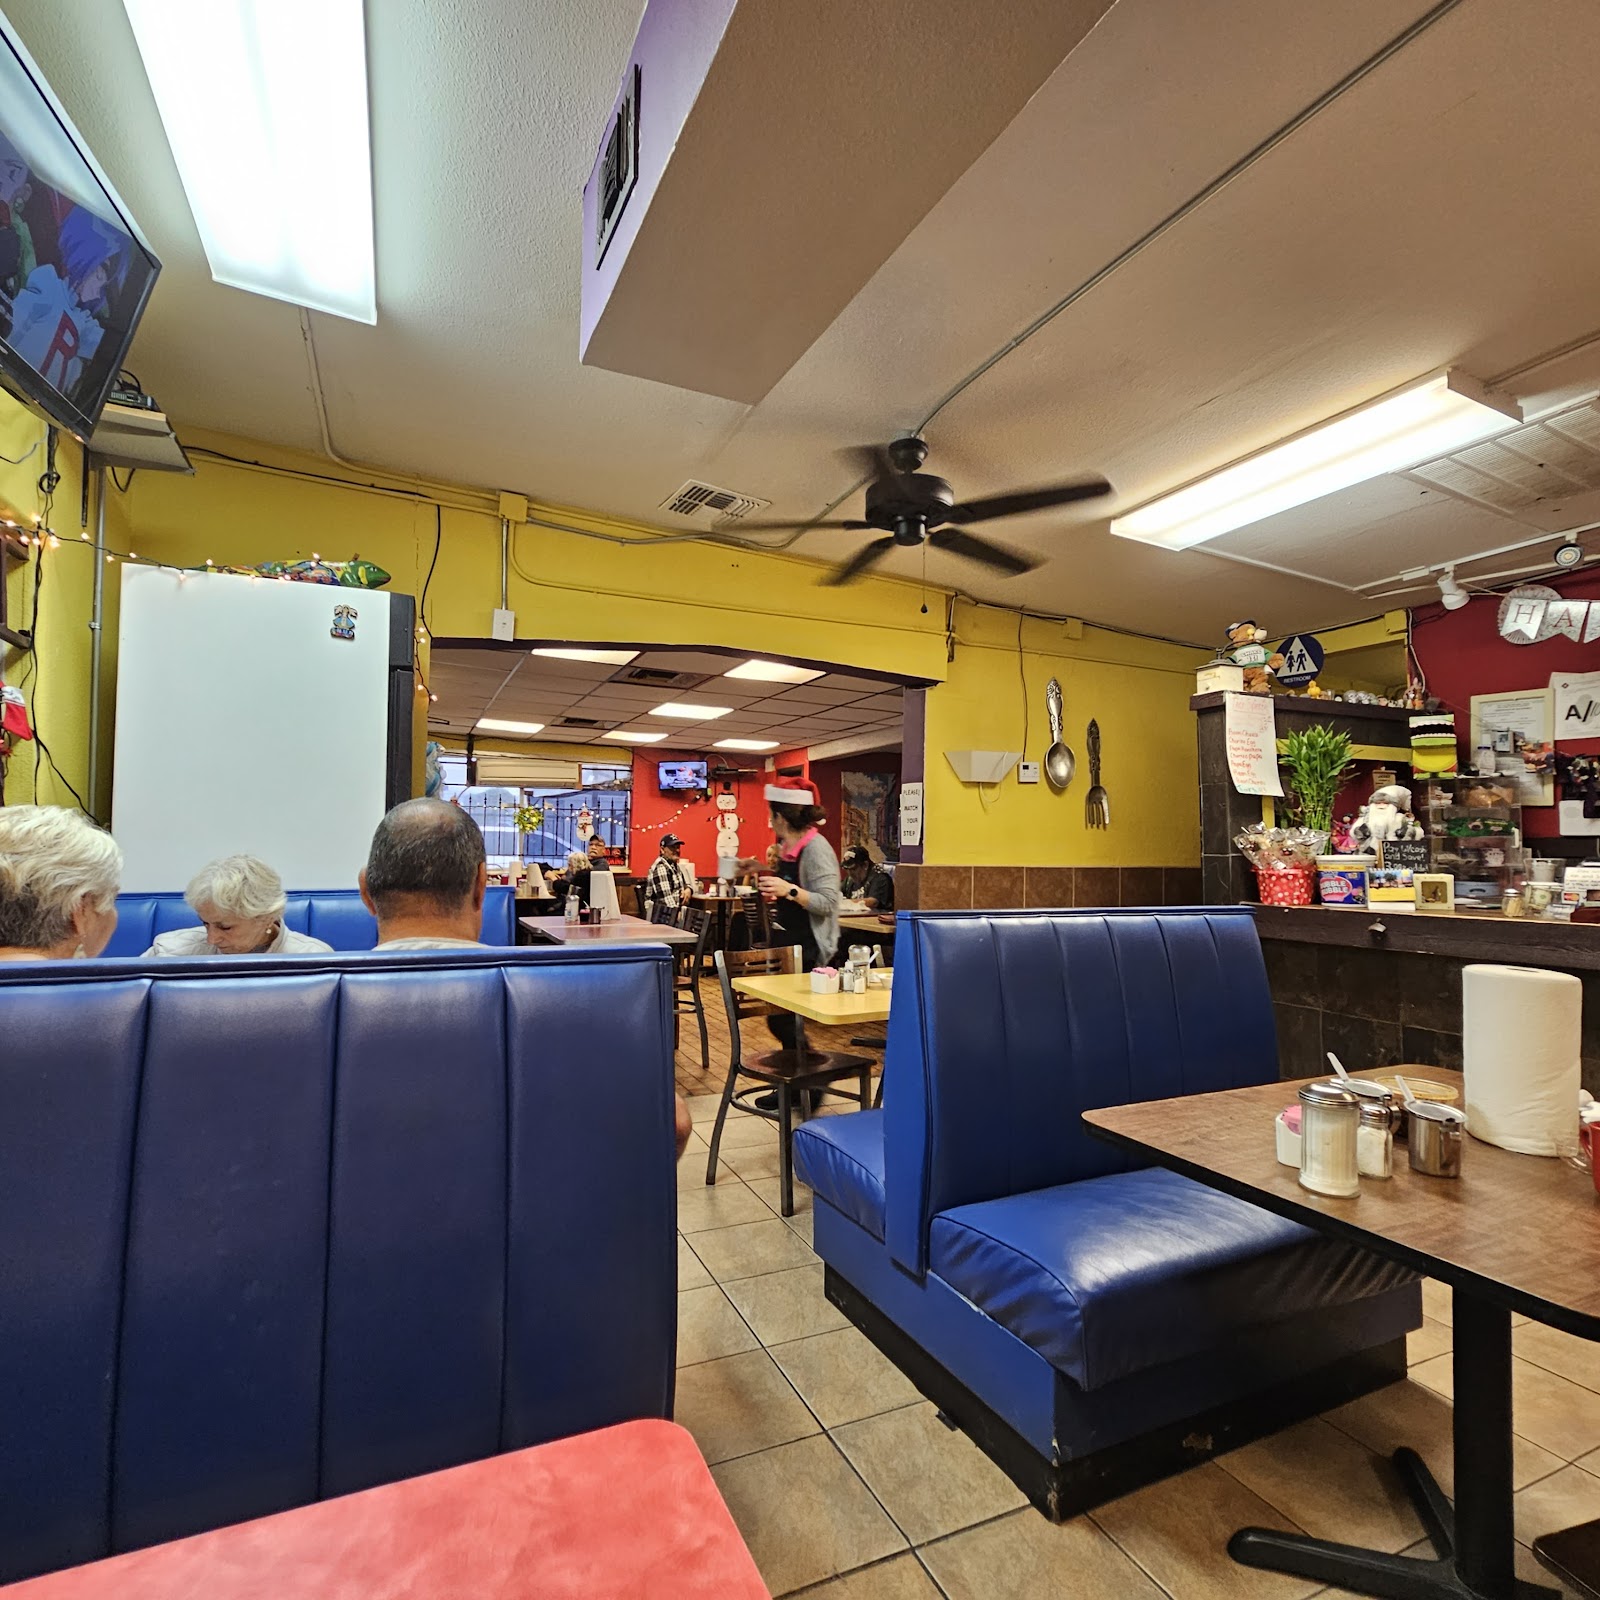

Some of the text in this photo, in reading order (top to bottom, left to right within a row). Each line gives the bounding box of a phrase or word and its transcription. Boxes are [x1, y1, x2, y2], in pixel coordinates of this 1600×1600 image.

[1283, 675, 1312, 684] RESTROOM
[1383, 841, 1400, 853] Pay
[1384, 852, 1401, 860] and
